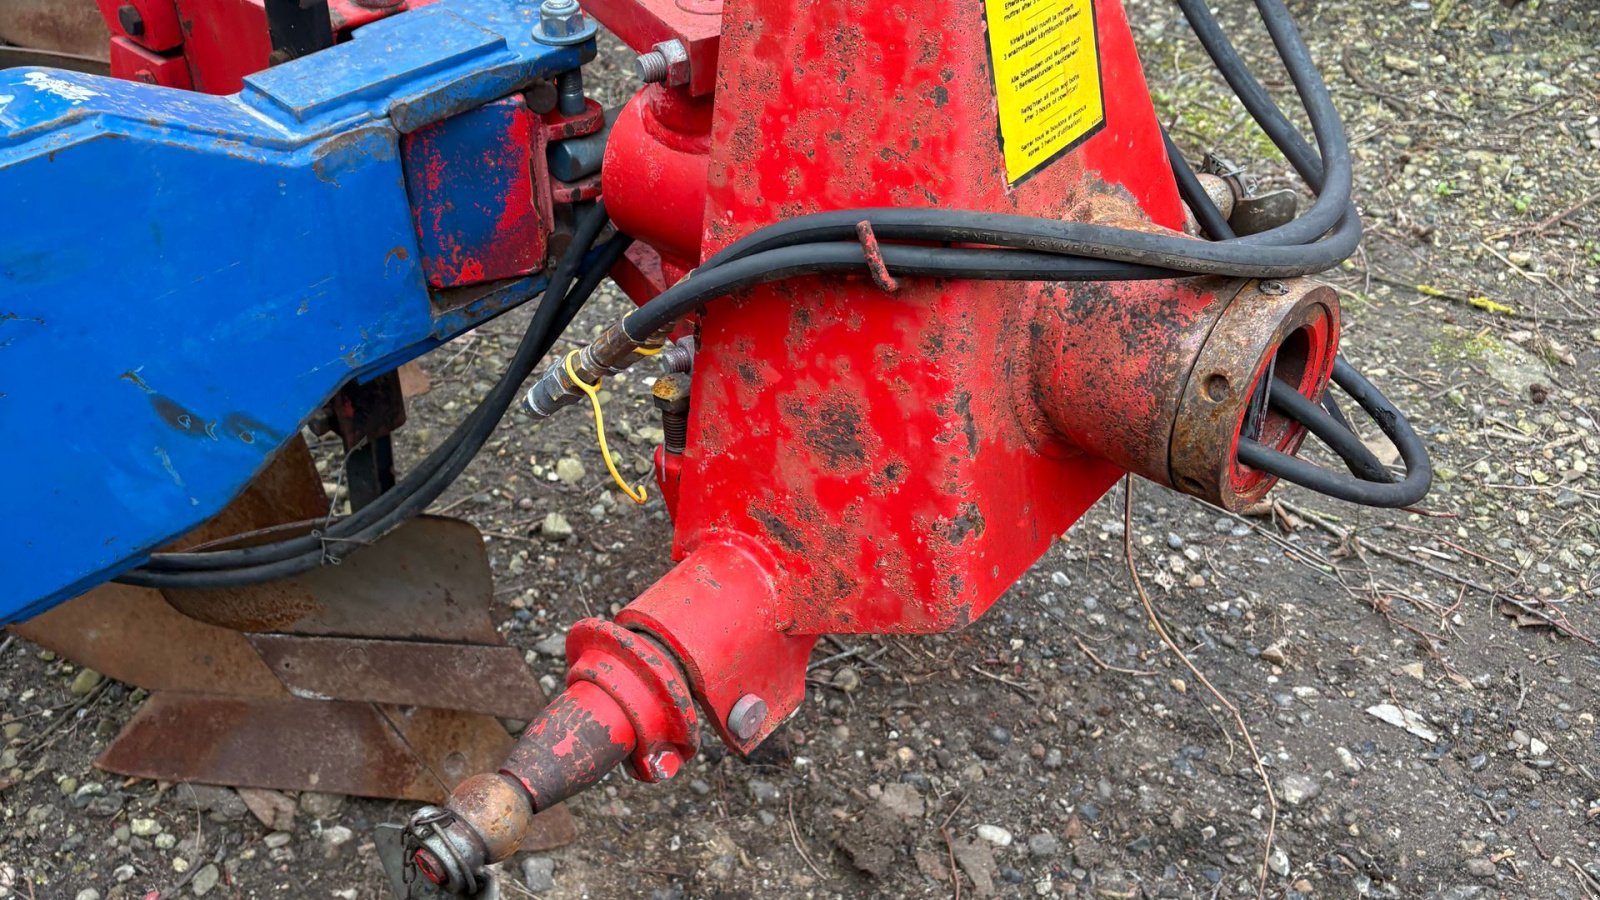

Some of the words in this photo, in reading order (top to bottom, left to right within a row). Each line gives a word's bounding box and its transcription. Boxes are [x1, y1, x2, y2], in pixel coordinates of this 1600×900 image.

[1052, 14, 1057, 22] ja
[1011, 75, 1019, 84] Alle
[1020, 60, 1044, 78] Schrauben
[1044, 53, 1053, 63] und
[1053, 43, 1070, 56] Muttern
[1071, 36, 1081, 46] nach
[1055, 46, 1080, 66] nachziehen!
[1049, 87, 1060, 97] nuts
[1060, 80, 1068, 90] and
[1068, 74, 1080, 84] bolts
[1039, 102, 1051, 113] hours
[1052, 97, 1057, 105] of
